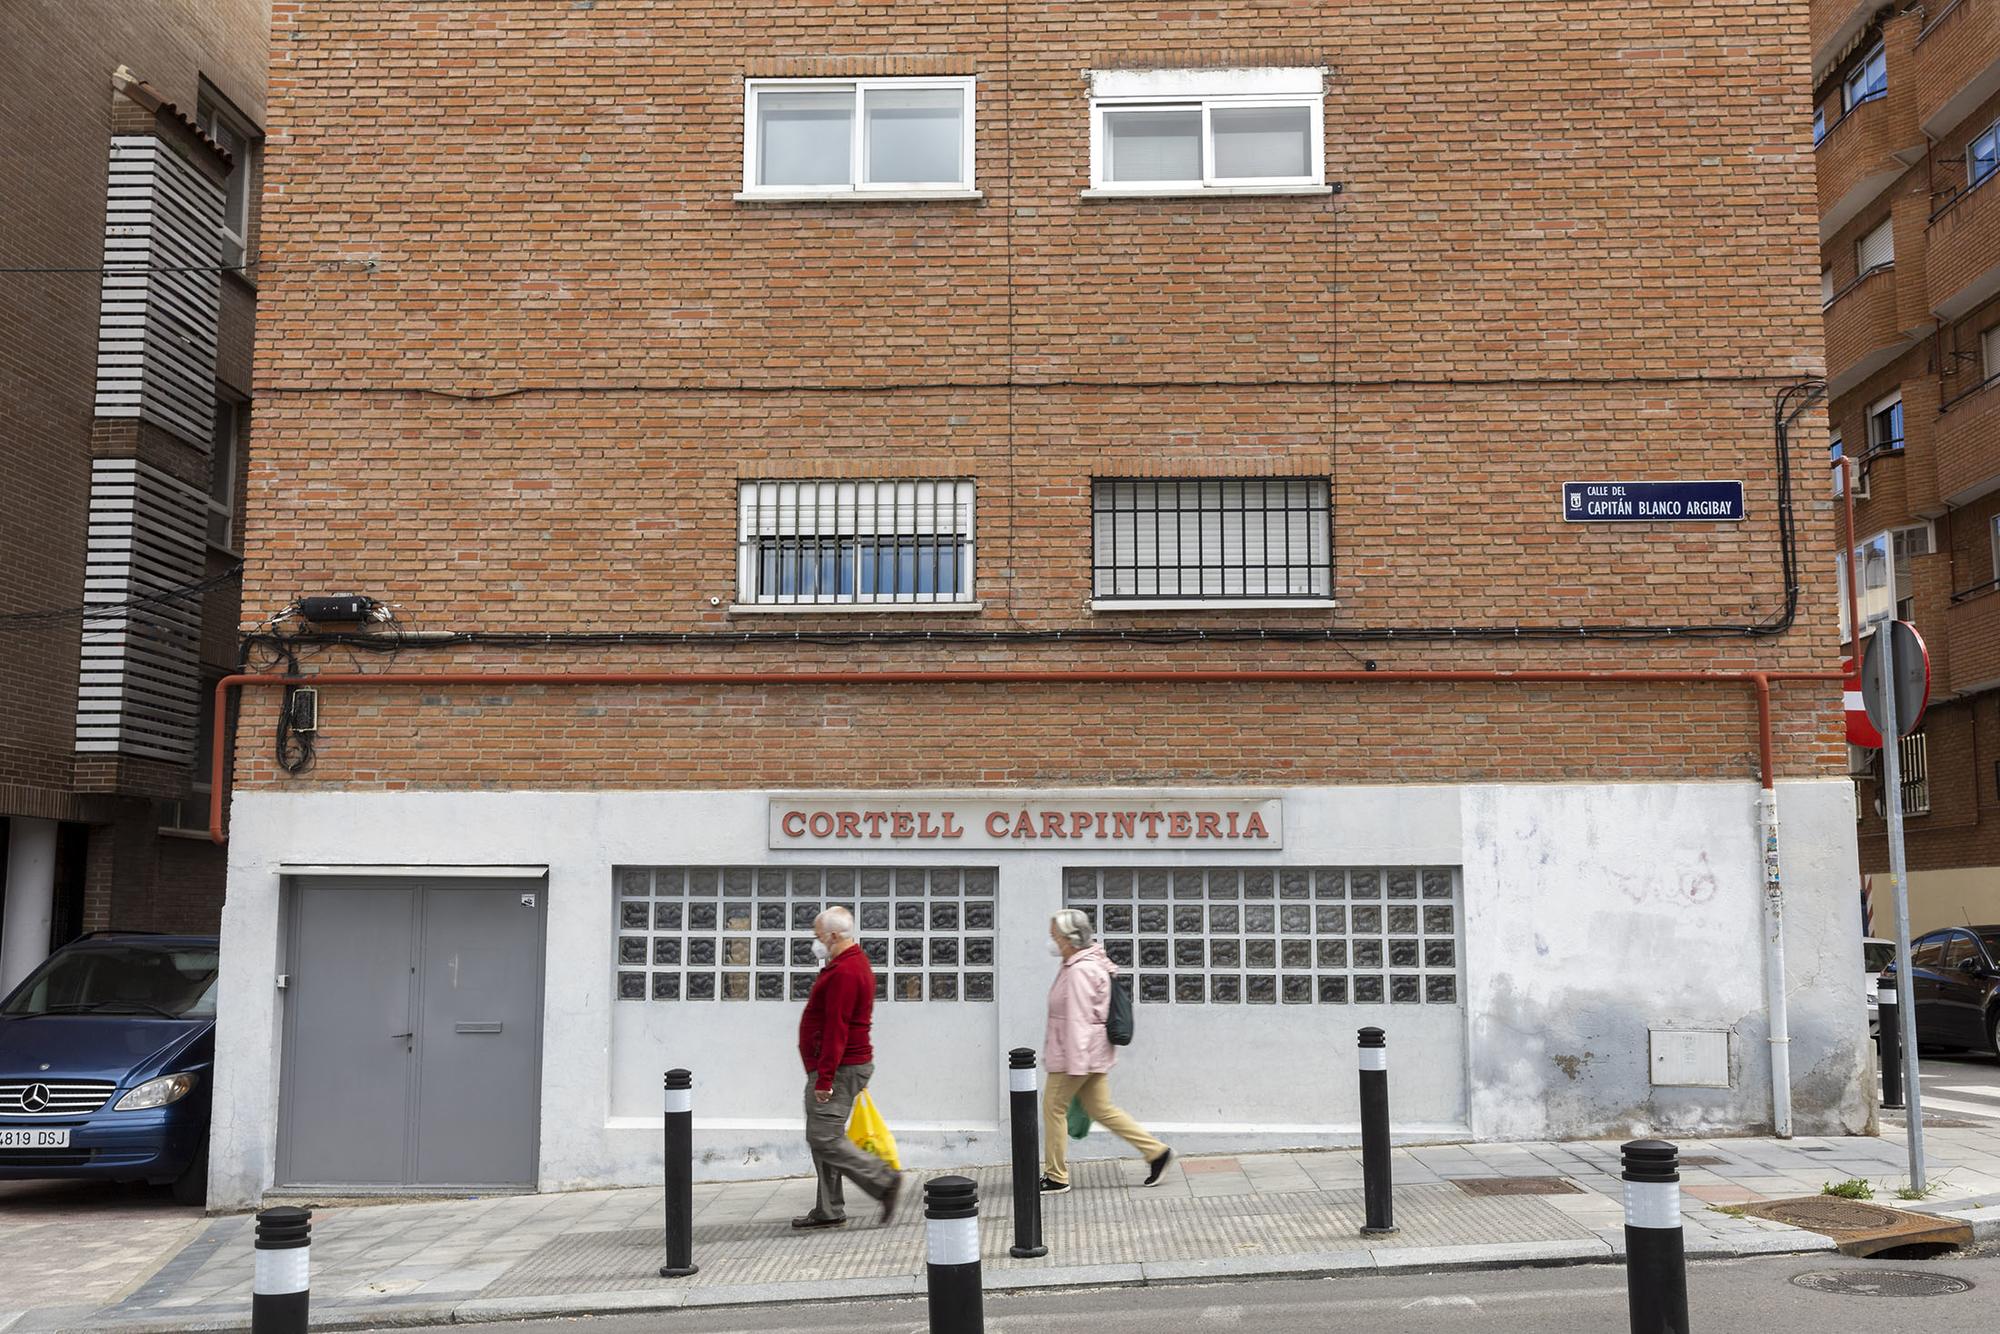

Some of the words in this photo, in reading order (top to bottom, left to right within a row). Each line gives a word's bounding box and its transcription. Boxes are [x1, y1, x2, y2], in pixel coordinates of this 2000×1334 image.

[1587, 486, 1608, 496] CALLE
[1612, 486, 1626, 496] DEL
[1588, 498, 1632, 515] CAPITÁN
[1638, 501, 1681, 515] BLANCO
[1686, 501, 1732, 515] ARGIBAY
[782, 811, 964, 838] CORTELL
[985, 810, 1269, 838] CARPINTERIA
[38, 1132, 65, 1145] DSJ
